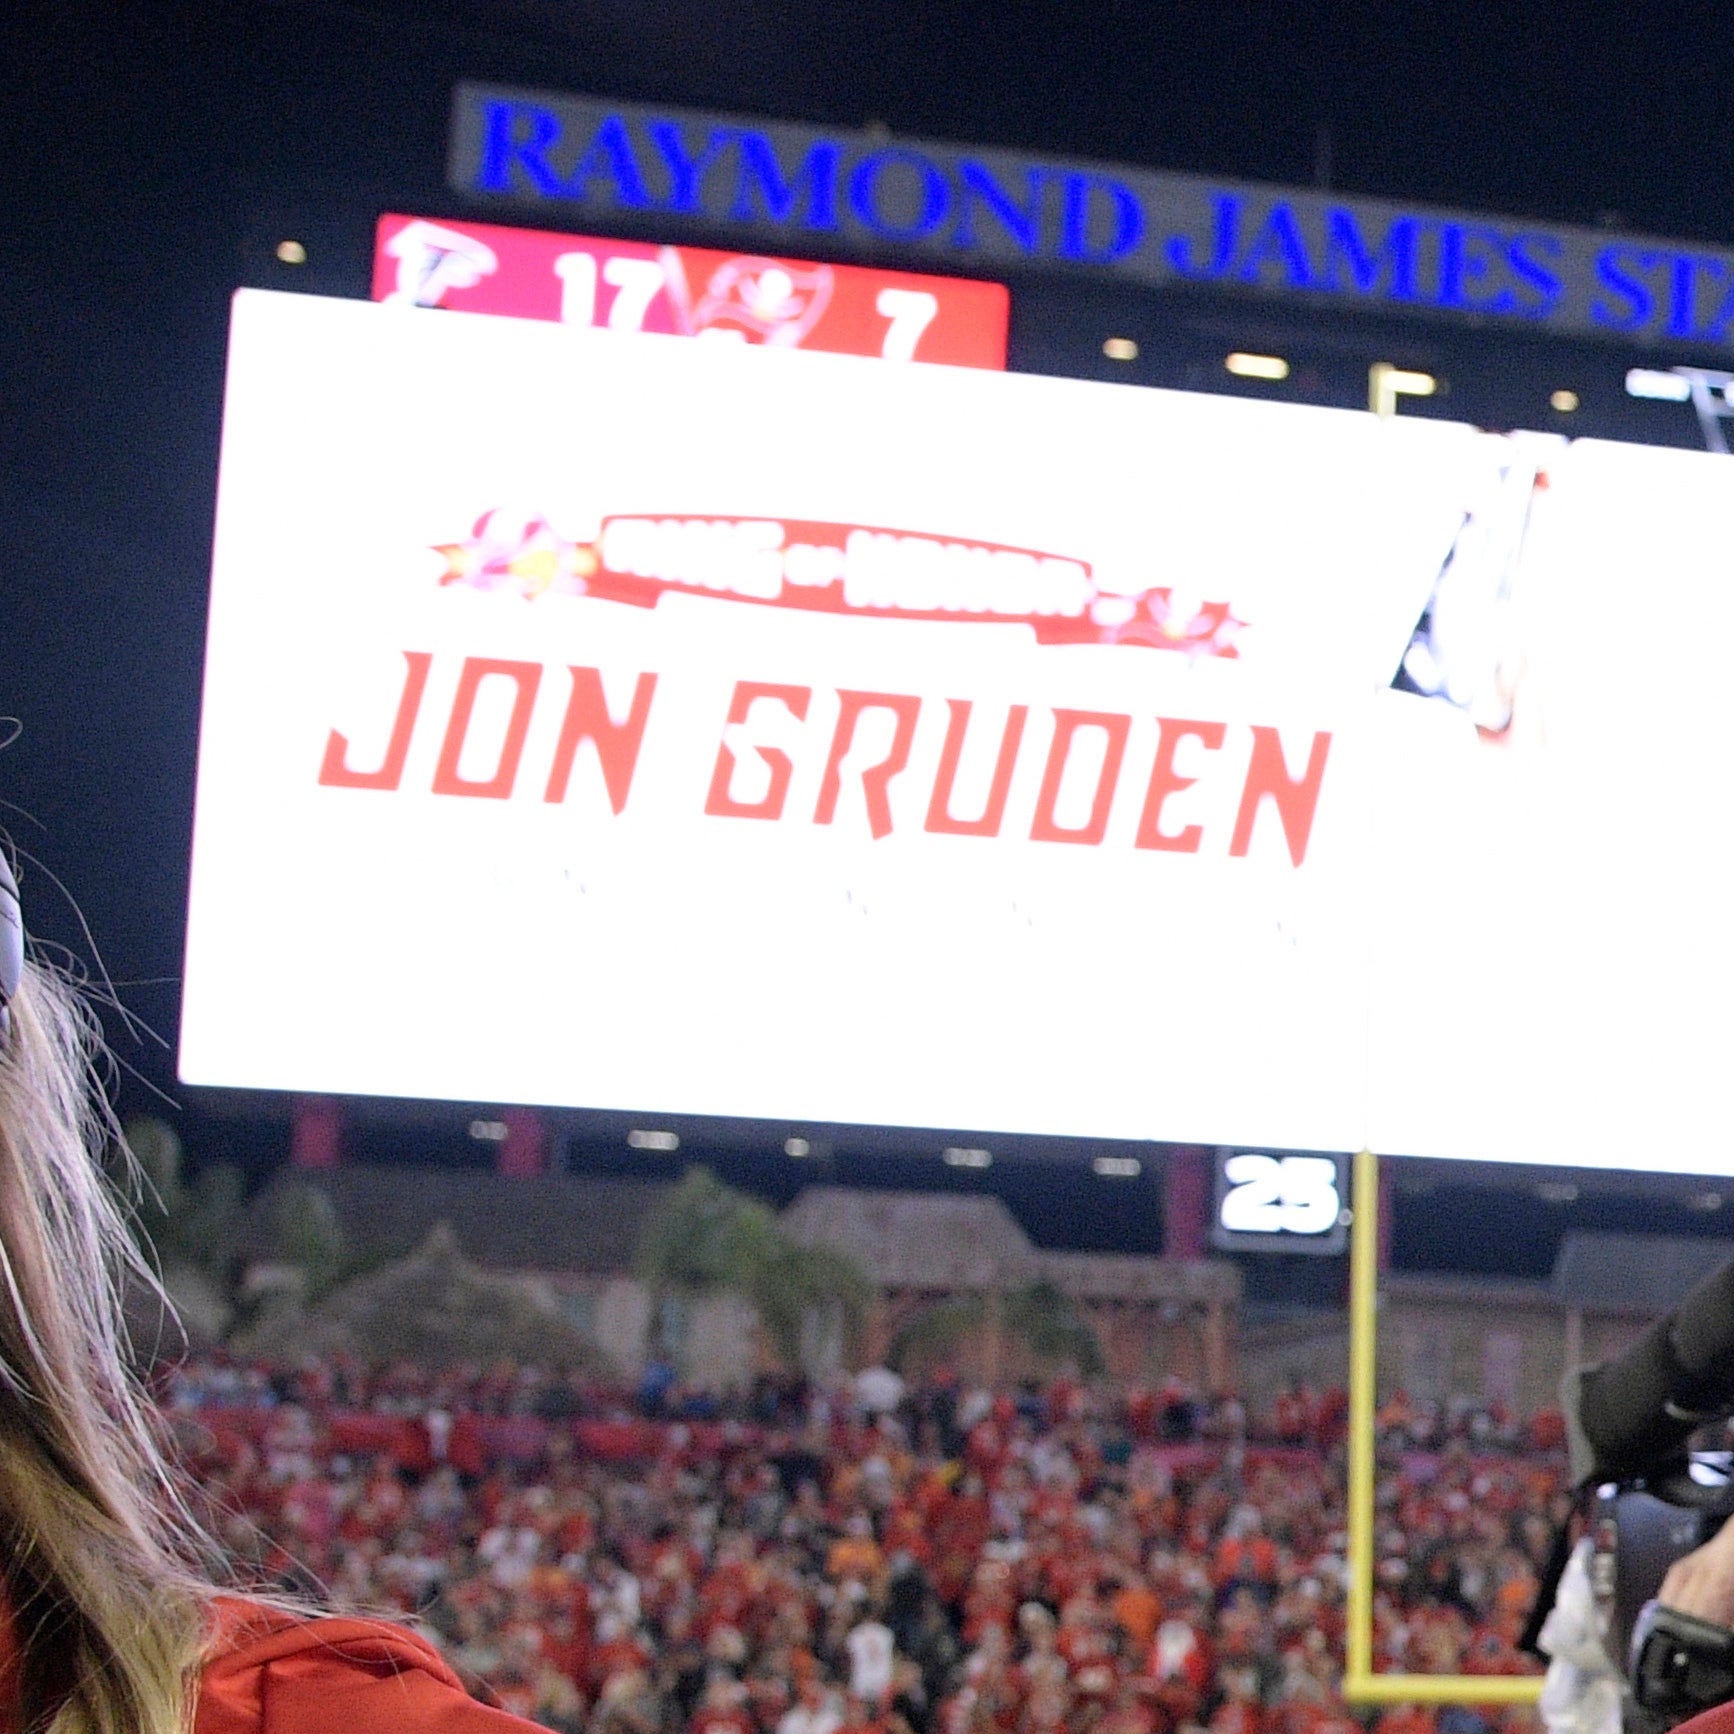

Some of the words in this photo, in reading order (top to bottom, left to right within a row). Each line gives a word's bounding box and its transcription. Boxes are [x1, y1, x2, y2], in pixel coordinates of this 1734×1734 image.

[475, 96, 1152, 266] RAYMOND
[1158, 187, 1569, 321] JAMES
[554, 252, 663, 331] 17
[876, 288, 938, 361] 7
[316, 649, 660, 817] JON
[703, 678, 1334, 870] GRUDEN
[1221, 1154, 1340, 1234] 25
